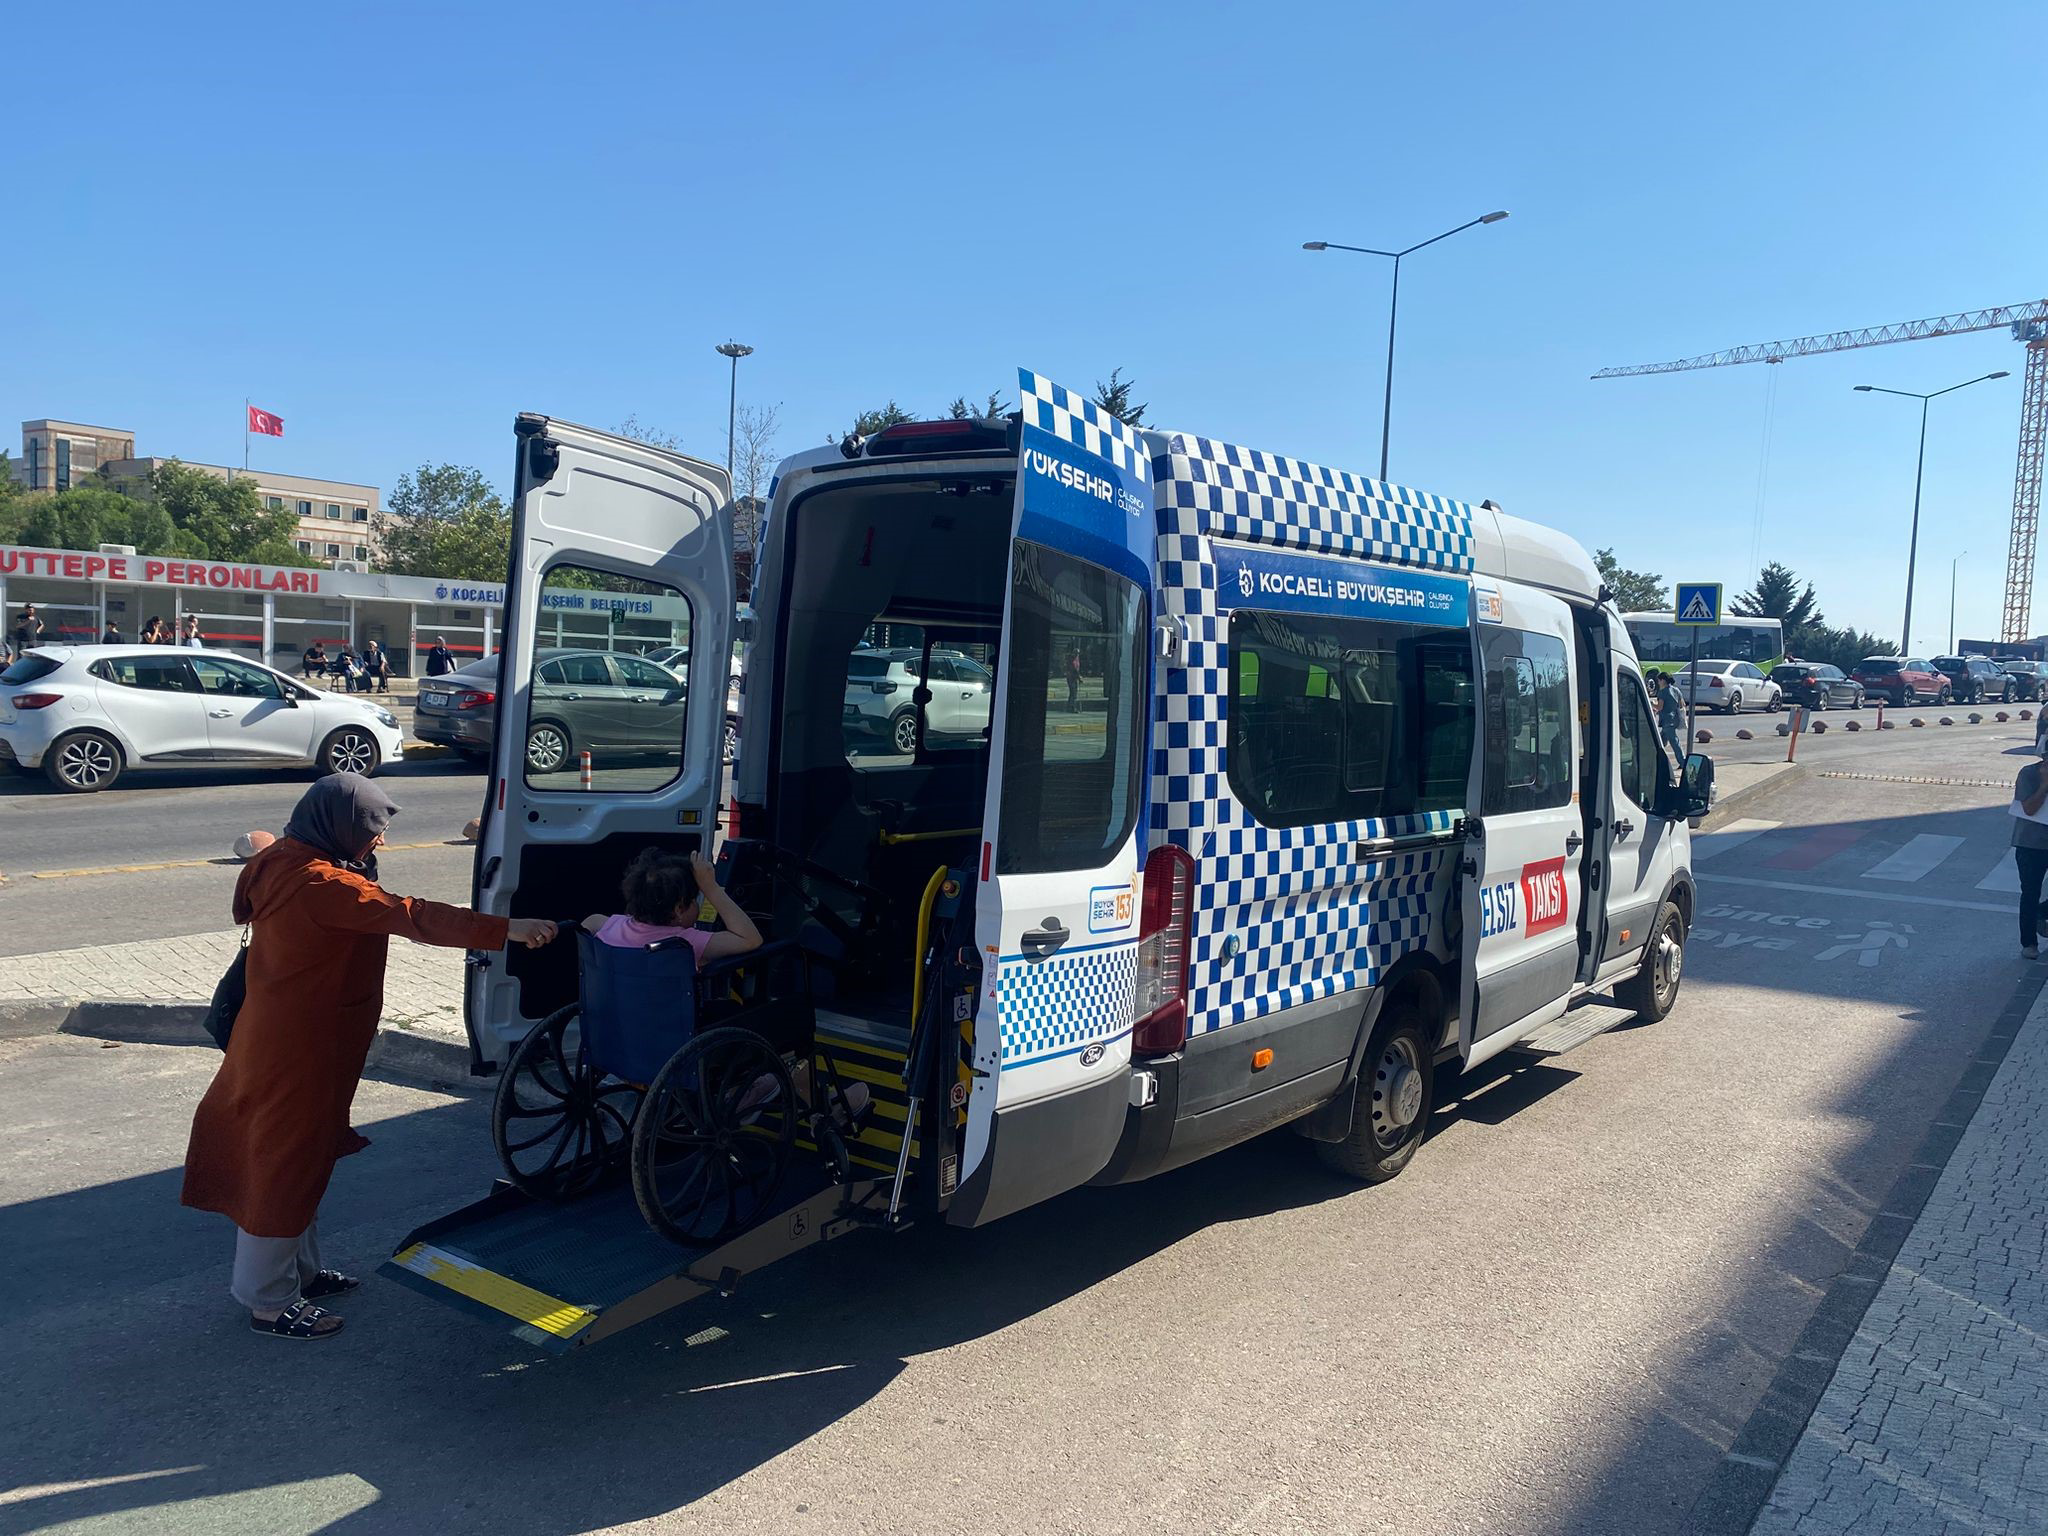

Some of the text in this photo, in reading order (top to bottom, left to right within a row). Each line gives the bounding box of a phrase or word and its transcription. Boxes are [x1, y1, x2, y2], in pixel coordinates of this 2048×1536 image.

[0, 550, 319, 594] UTTEPE PERONLARI
[1259, 572, 1425, 608] KOCAELİ BÜYÜKŞEHİR
[451, 586, 504, 603] KOCAELİ
[1115, 893, 1132, 921] 153
[1528, 869, 1562, 923] TAKSİ
